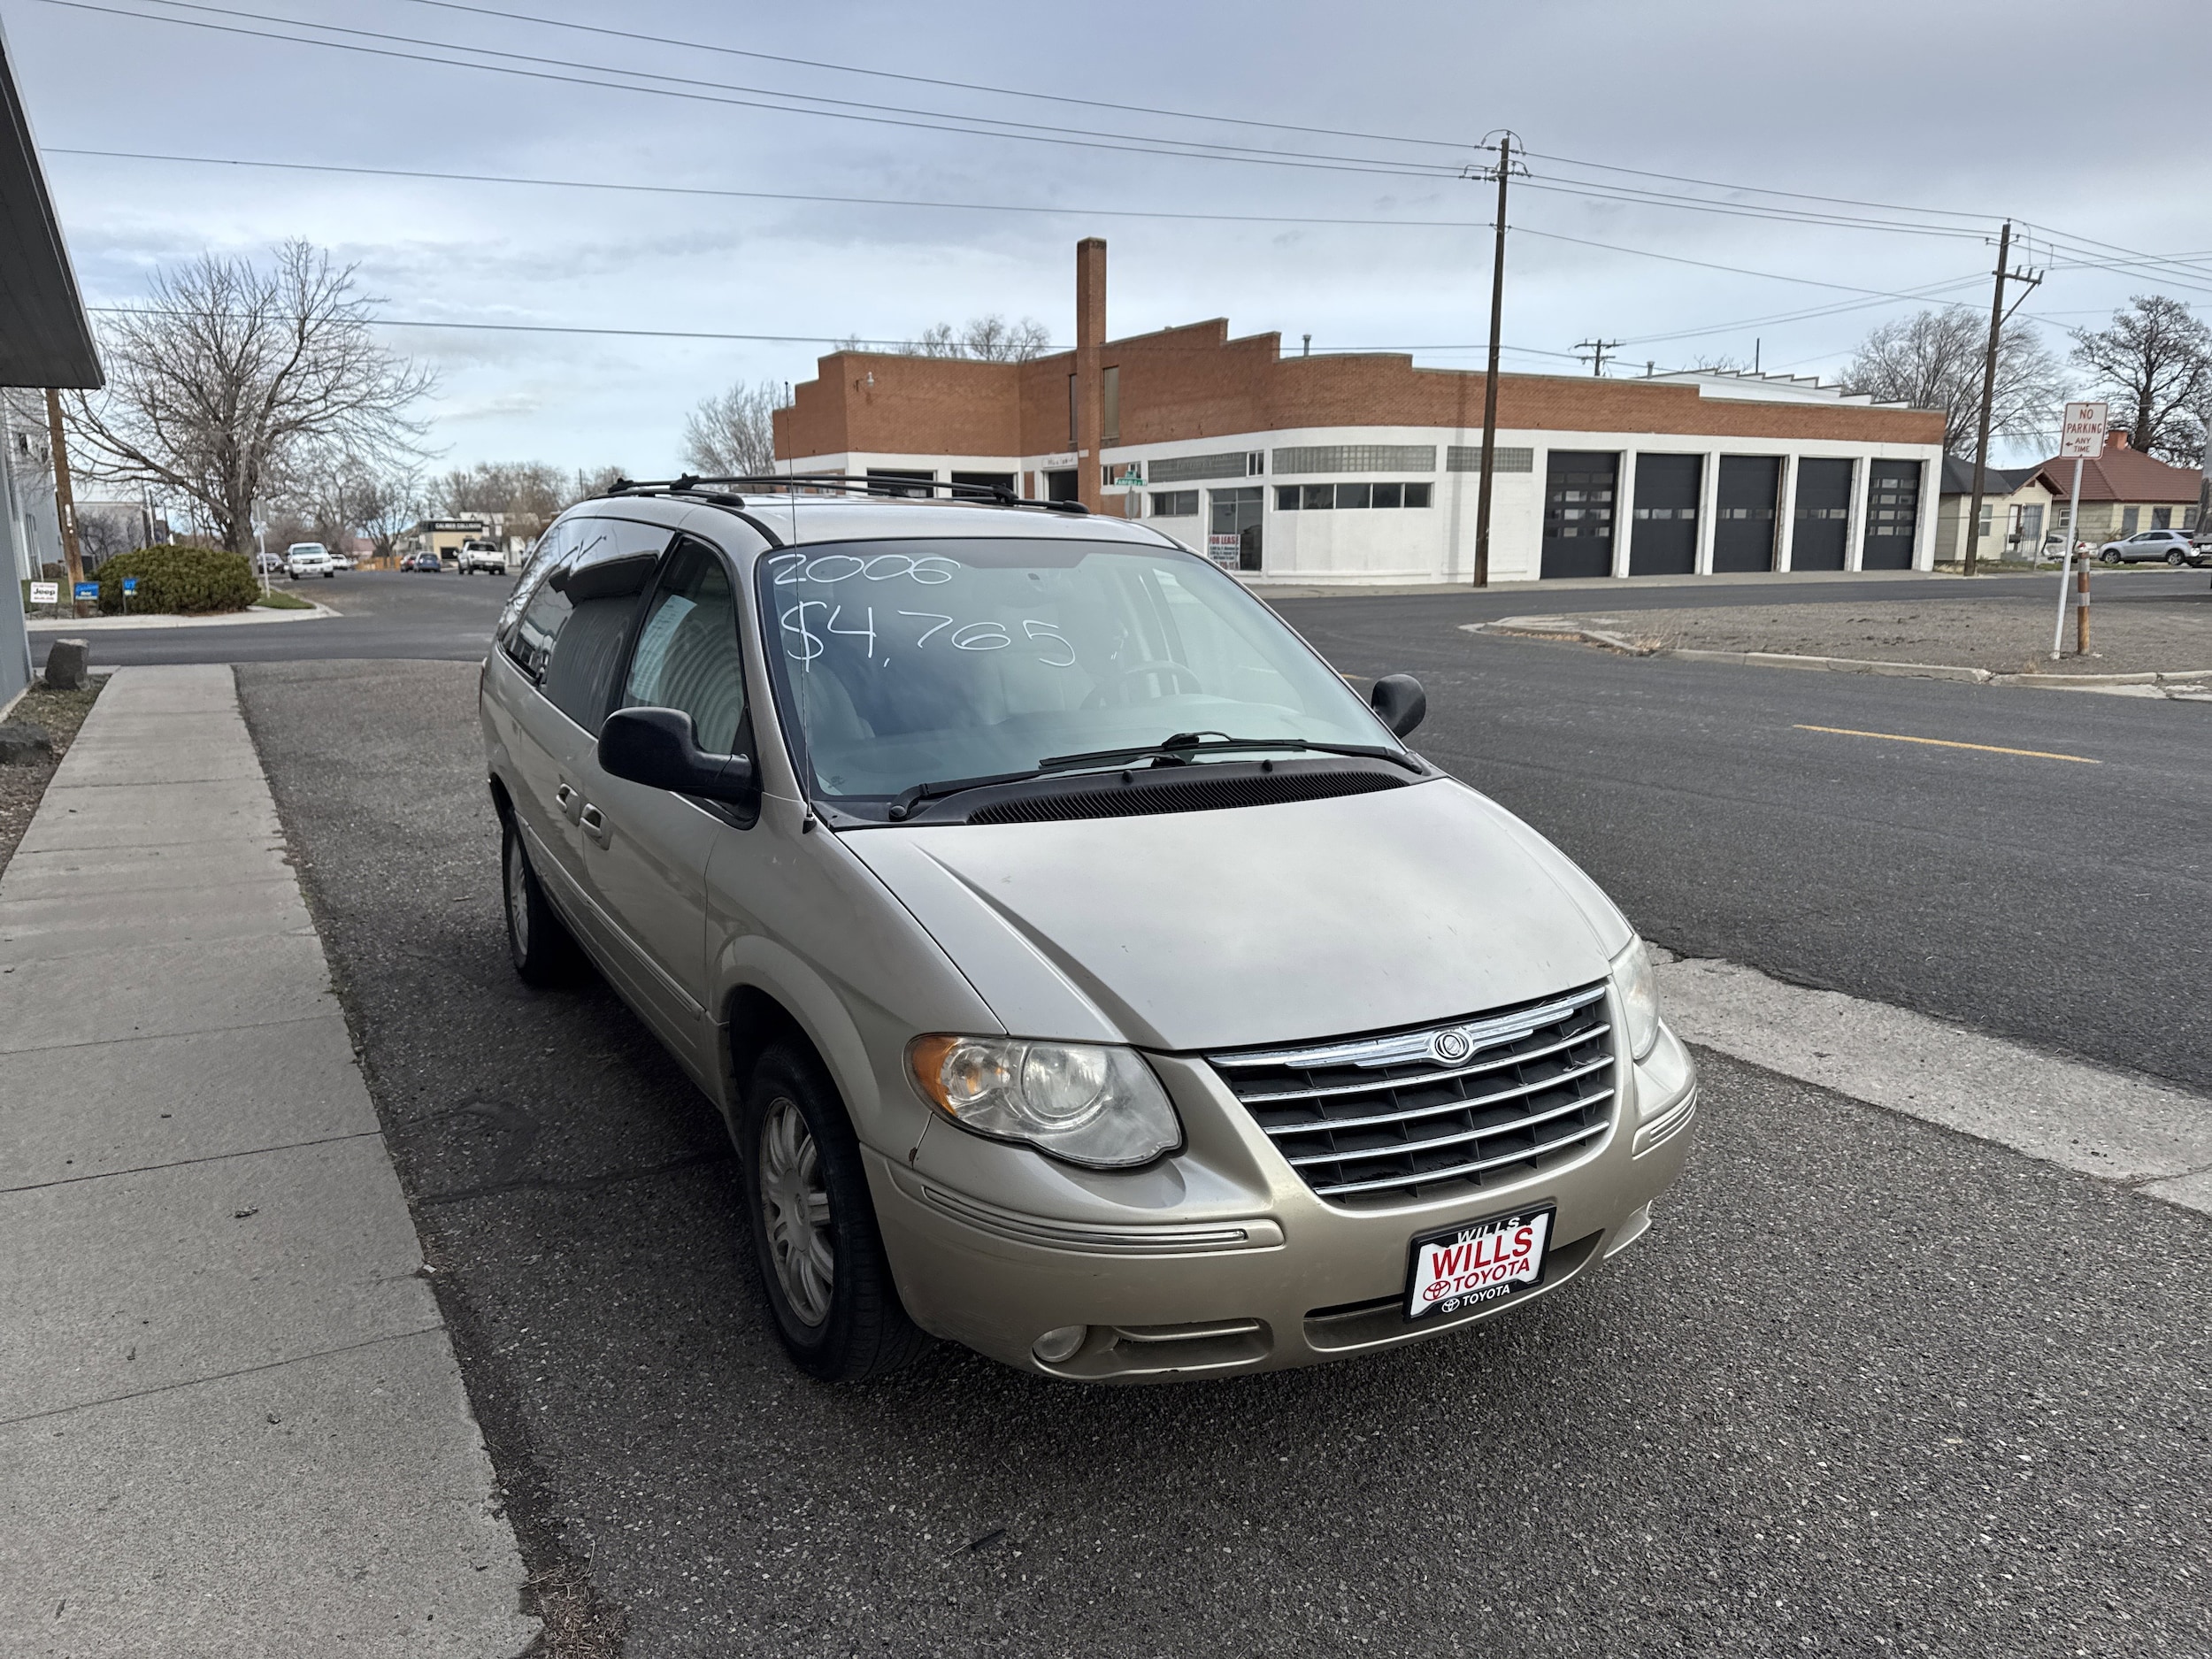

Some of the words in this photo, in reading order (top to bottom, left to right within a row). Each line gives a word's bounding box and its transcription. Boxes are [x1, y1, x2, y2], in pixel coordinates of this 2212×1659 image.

[2079, 409, 2093, 419] NO
[2066, 423, 2102, 434] PARKING
[1209, 535, 1220, 545] FOR
[768, 554, 961, 585] 2006
[781, 601, 1076, 672] $4,765
[1457, 1217, 1521, 1245] WILLS
[1432, 1227, 1533, 1280] WILLS
[1453, 1257, 1530, 1293] TOYOTA
[1462, 1283, 1510, 1307] TOYOTA
